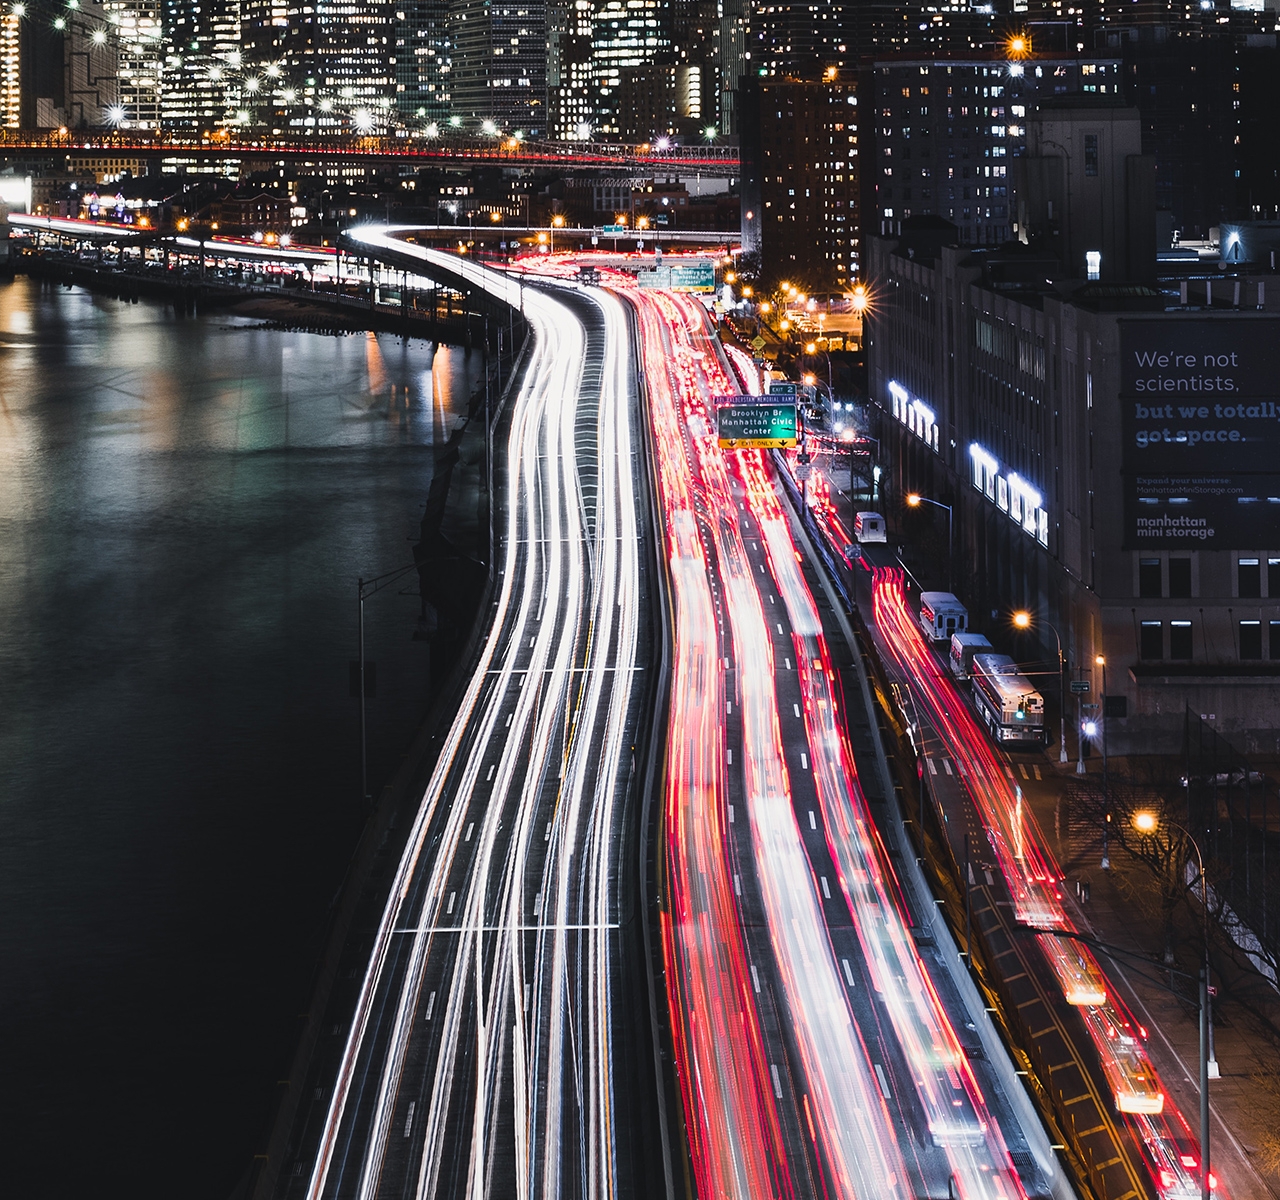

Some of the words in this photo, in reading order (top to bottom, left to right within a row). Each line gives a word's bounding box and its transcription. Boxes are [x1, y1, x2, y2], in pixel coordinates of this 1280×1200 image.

[1134, 351, 1196, 367] We're
[1204, 352, 1238, 367] not
[1135, 375, 1239, 392] scientists,
[1135, 403, 1174, 419] but
[1178, 406, 1209, 419] we
[1136, 428, 1171, 448] got
[1176, 429, 1246, 446] space.
[1136, 477, 1169, 486] Expand
[1171, 478, 1191, 486] your
[1136, 486, 1244, 496] ManhattanMiniStorage.com
[1136, 512, 1207, 527] manhattan
[1137, 527, 1163, 537] mini
[1165, 527, 1215, 540] storage
